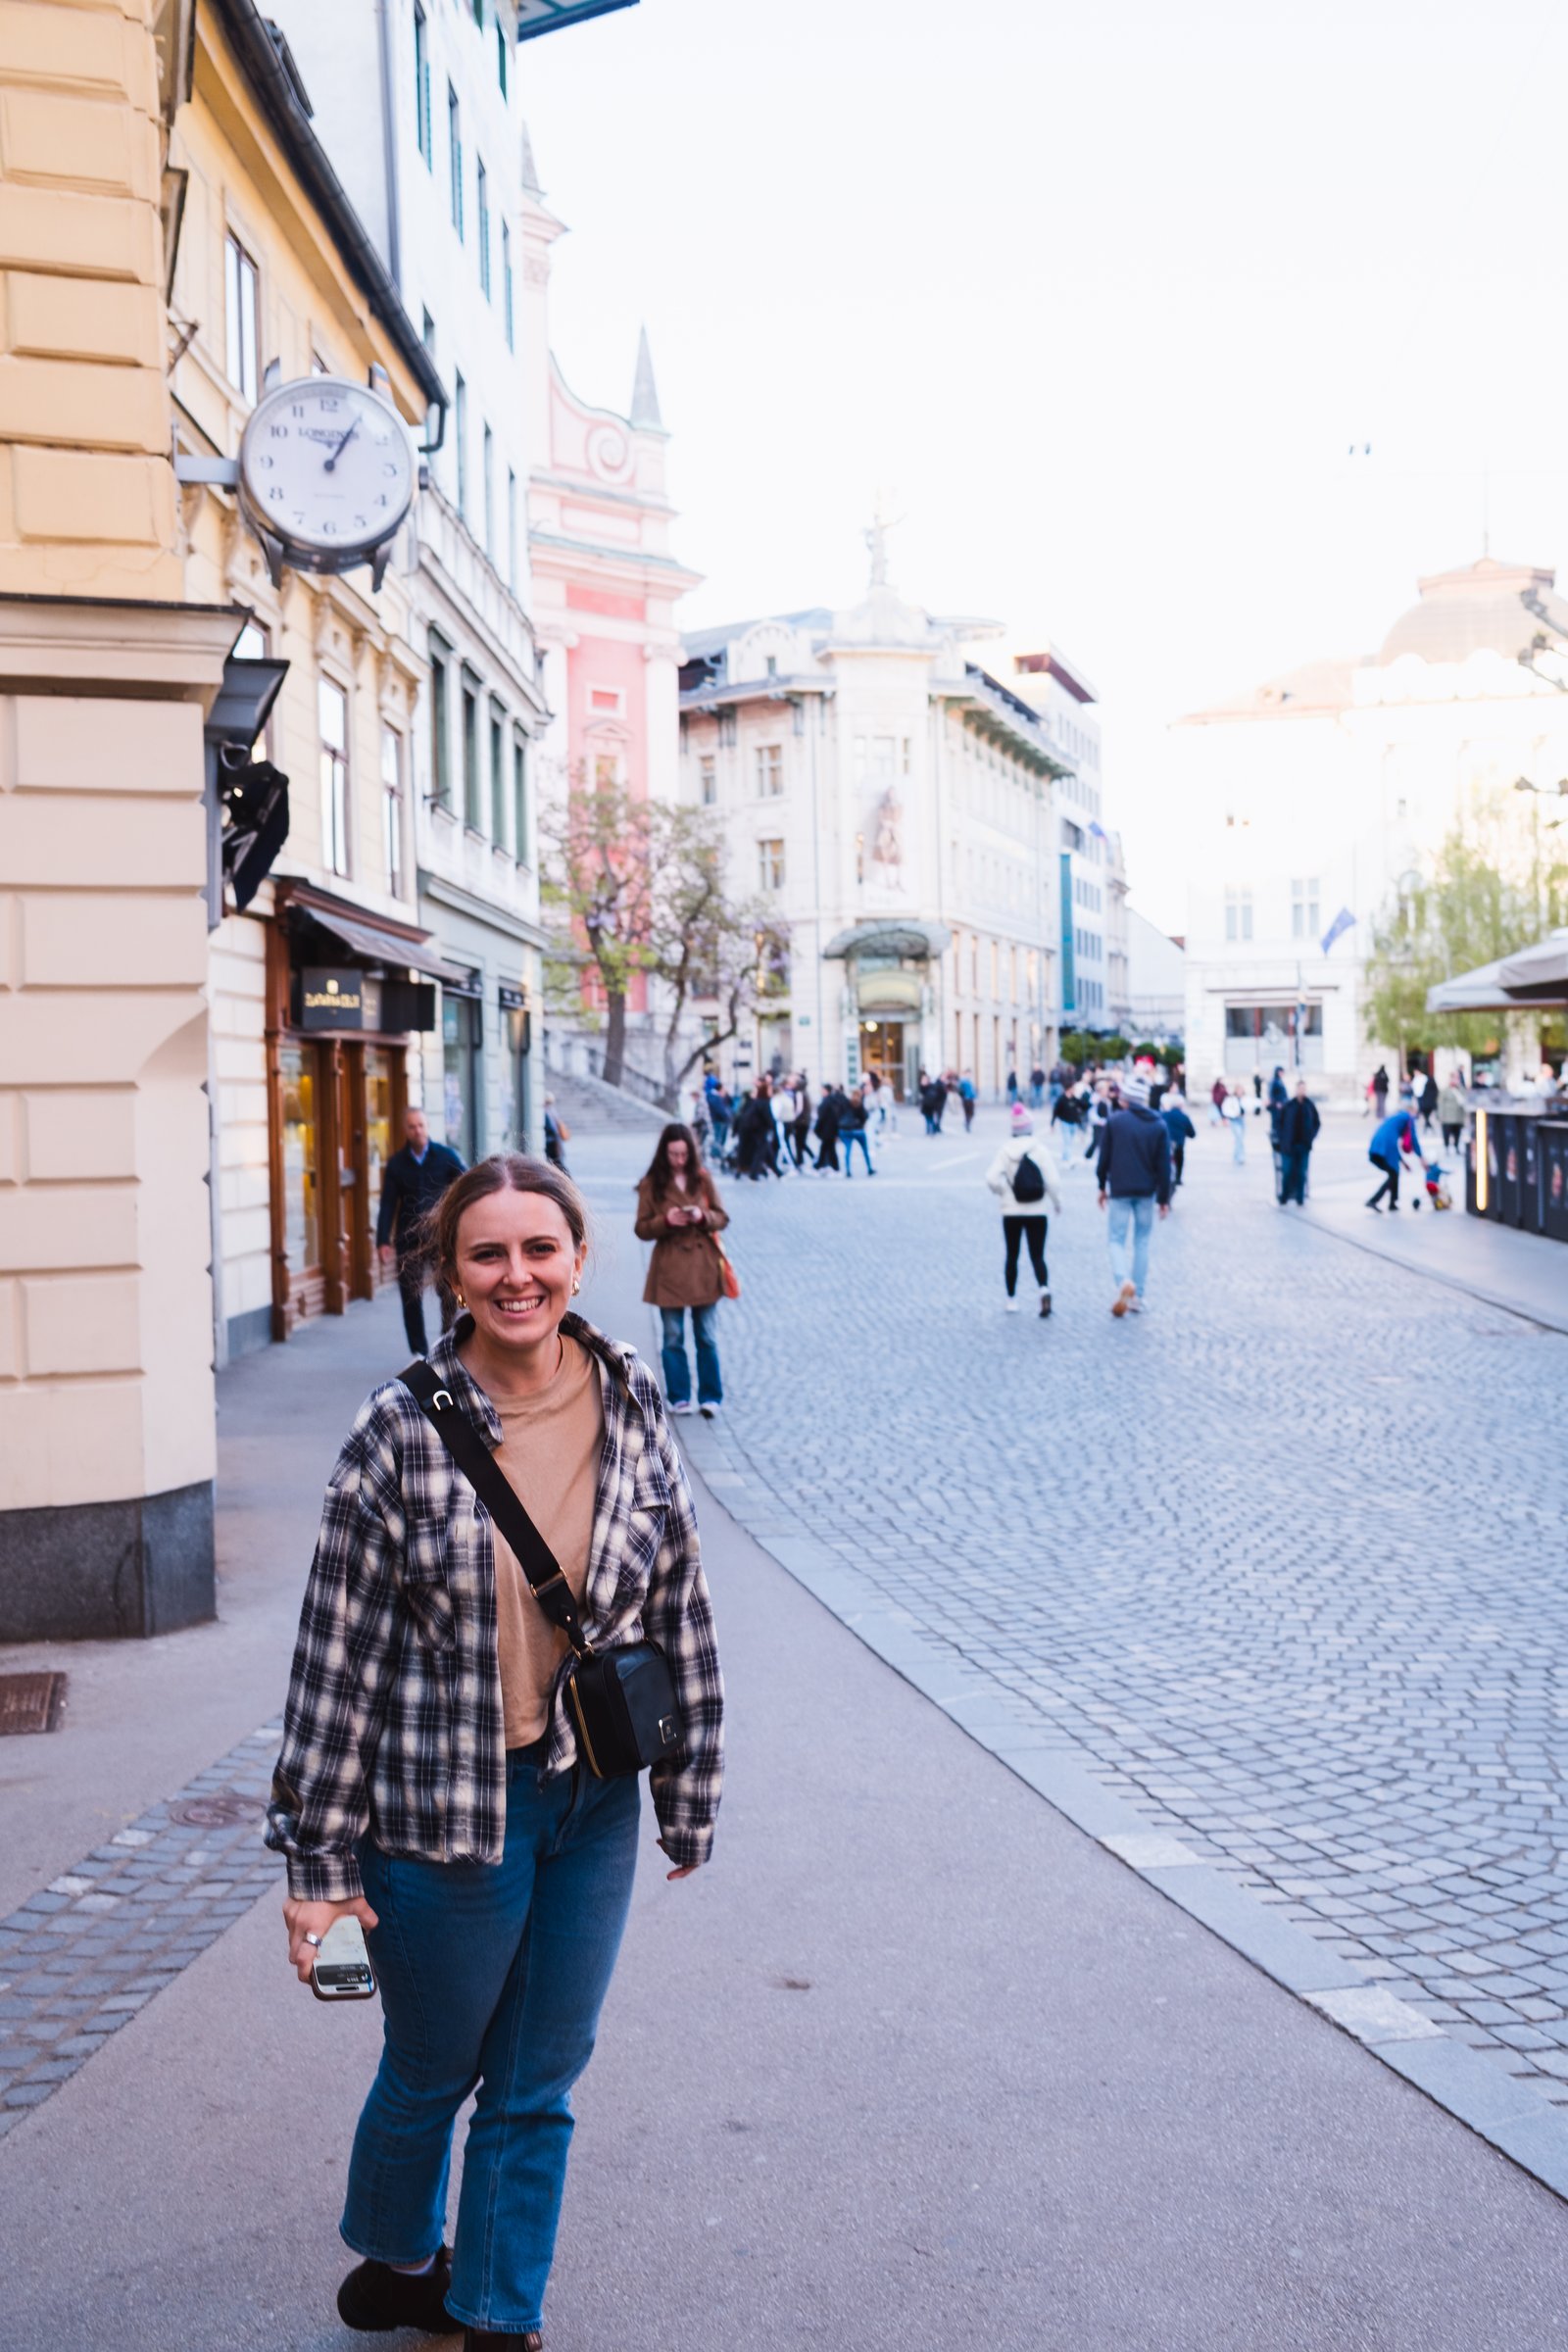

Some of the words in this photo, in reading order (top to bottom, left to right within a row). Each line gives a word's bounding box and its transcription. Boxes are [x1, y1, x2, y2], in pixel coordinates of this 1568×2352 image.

[292, 405, 305, 418] 11
[320, 398, 338, 413] 12
[270, 425, 288, 439] 10
[260, 456, 274, 469] 9
[270, 487, 283, 501] 8
[293, 511, 306, 525] 7
[354, 514, 367, 529] 5
[322, 520, 337, 534] 6
